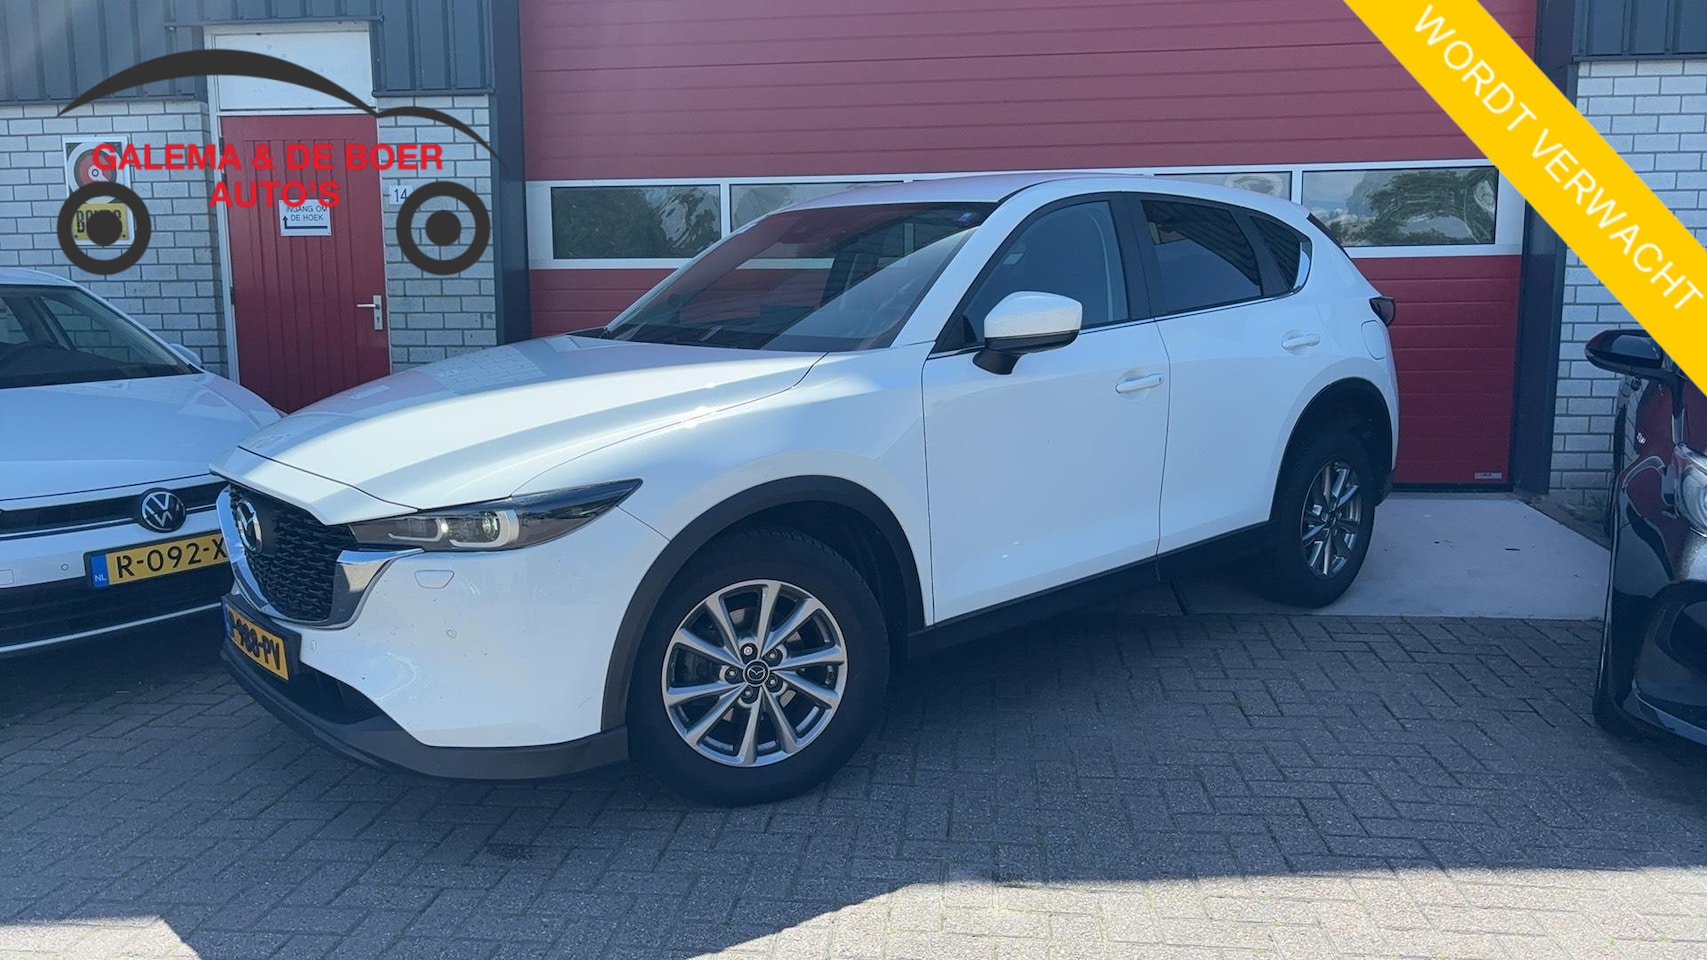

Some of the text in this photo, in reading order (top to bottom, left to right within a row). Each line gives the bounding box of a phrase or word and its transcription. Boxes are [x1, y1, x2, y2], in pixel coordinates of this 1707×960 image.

[394, 188, 408, 203] 14
[303, 213, 324, 221] HOEK
[94, 573, 107, 582] NL
